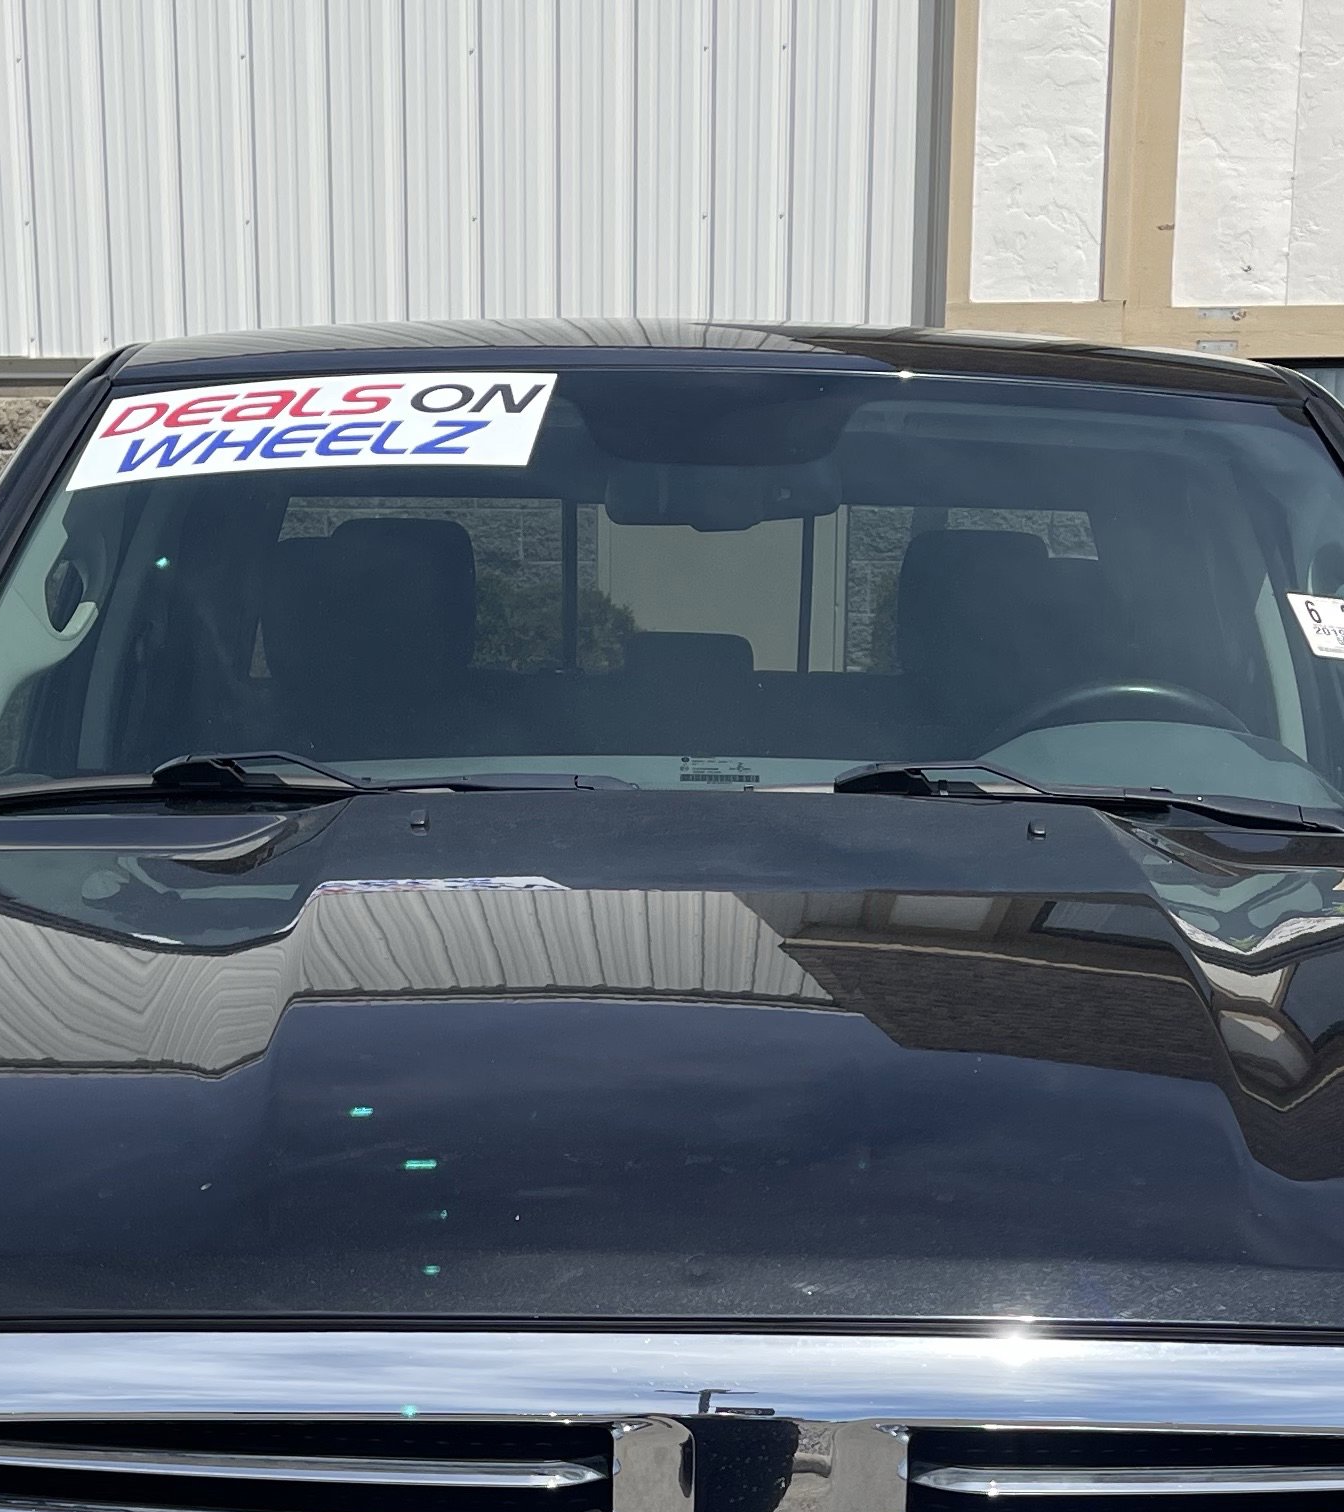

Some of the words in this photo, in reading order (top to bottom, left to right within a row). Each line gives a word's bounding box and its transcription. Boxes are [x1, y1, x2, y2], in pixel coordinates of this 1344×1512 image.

[100, 383, 406, 438] DEALS
[410, 383, 547, 413] ON
[117, 420, 492, 474] WHEELZ
[1305, 600, 1322, 624] 6
